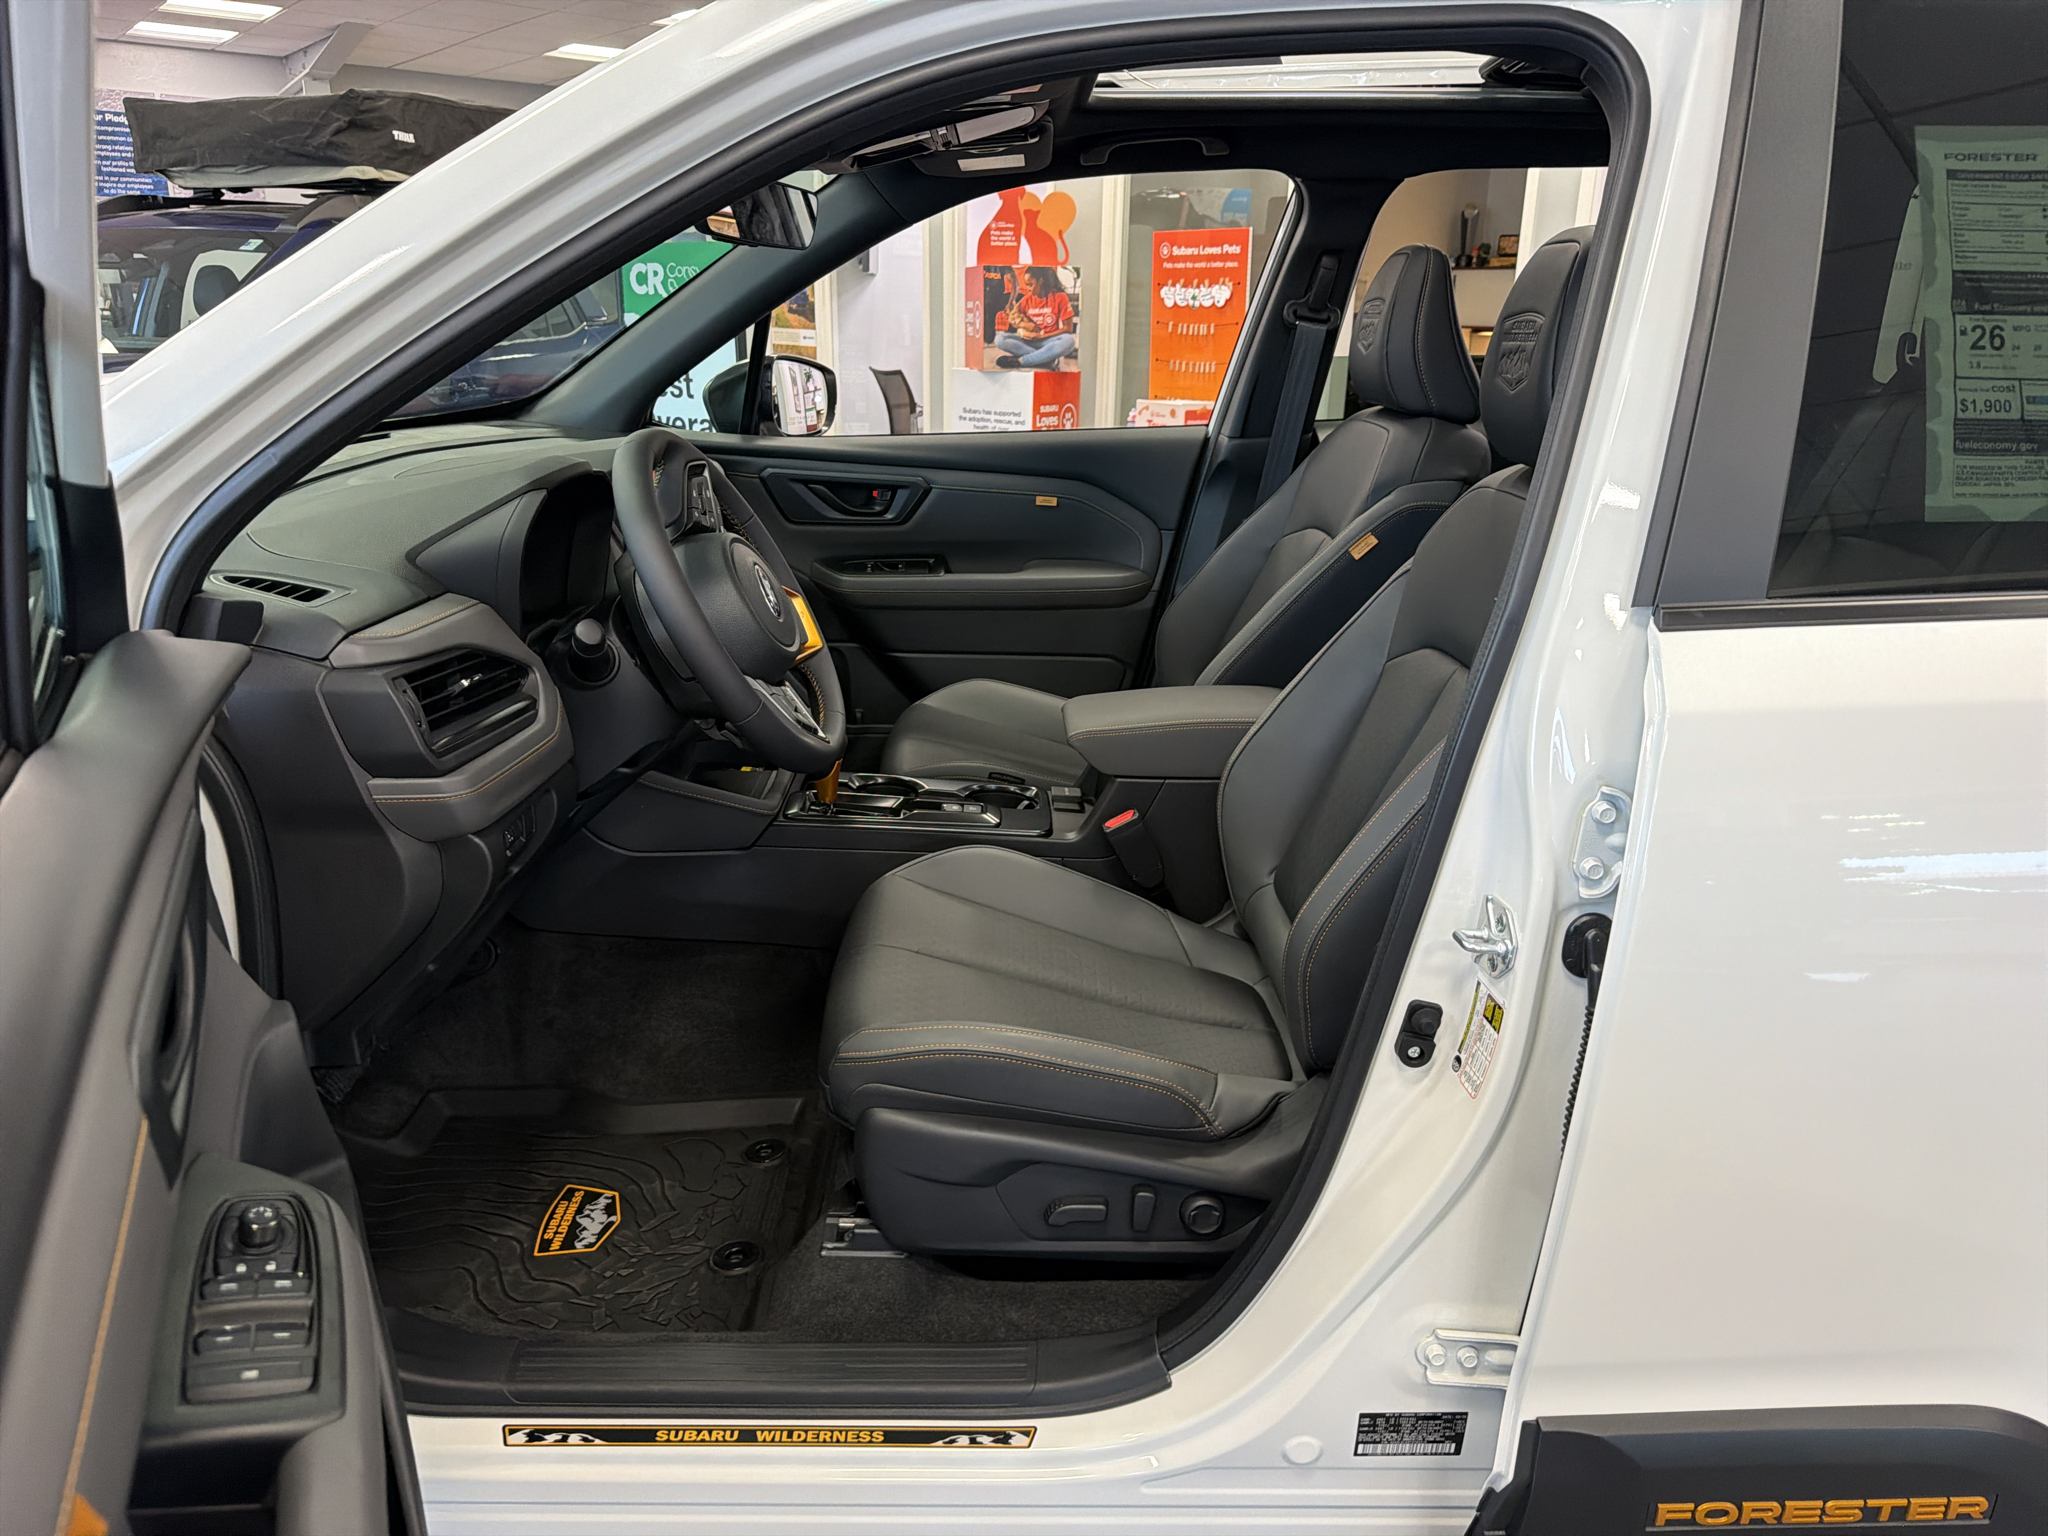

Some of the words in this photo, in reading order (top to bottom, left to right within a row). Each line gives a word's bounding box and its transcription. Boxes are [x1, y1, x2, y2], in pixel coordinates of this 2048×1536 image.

[1944, 152, 2040, 162] FORESTER
[1171, 244, 1199, 256] Subaru
[1199, 243, 1222, 256] Loves
[1222, 243, 1242, 255] Pets
[1173, 261, 1185, 269] make
[1185, 261, 1194, 269] the
[1194, 261, 1207, 269] world
[630, 262, 668, 298] CR
[1970, 324, 2006, 351] 26
[962, 407, 981, 415] Subaru
[982, 408, 993, 416] has
[993, 410, 1022, 418] supported
[1039, 404, 1060, 413] SUBARU
[1960, 398, 2012, 415] $1,900
[1036, 414, 1059, 428] Loves
[1955, 439, 2039, 452] fueleconomy.gov
[543, 1200, 569, 1240] SUBARU
[549, 1190, 585, 1251] WILDERNESS
[655, 1429, 740, 1442] SUBARU
[755, 1429, 885, 1443] WILDERNESS
[1655, 1496, 1990, 1528] FORESTER
